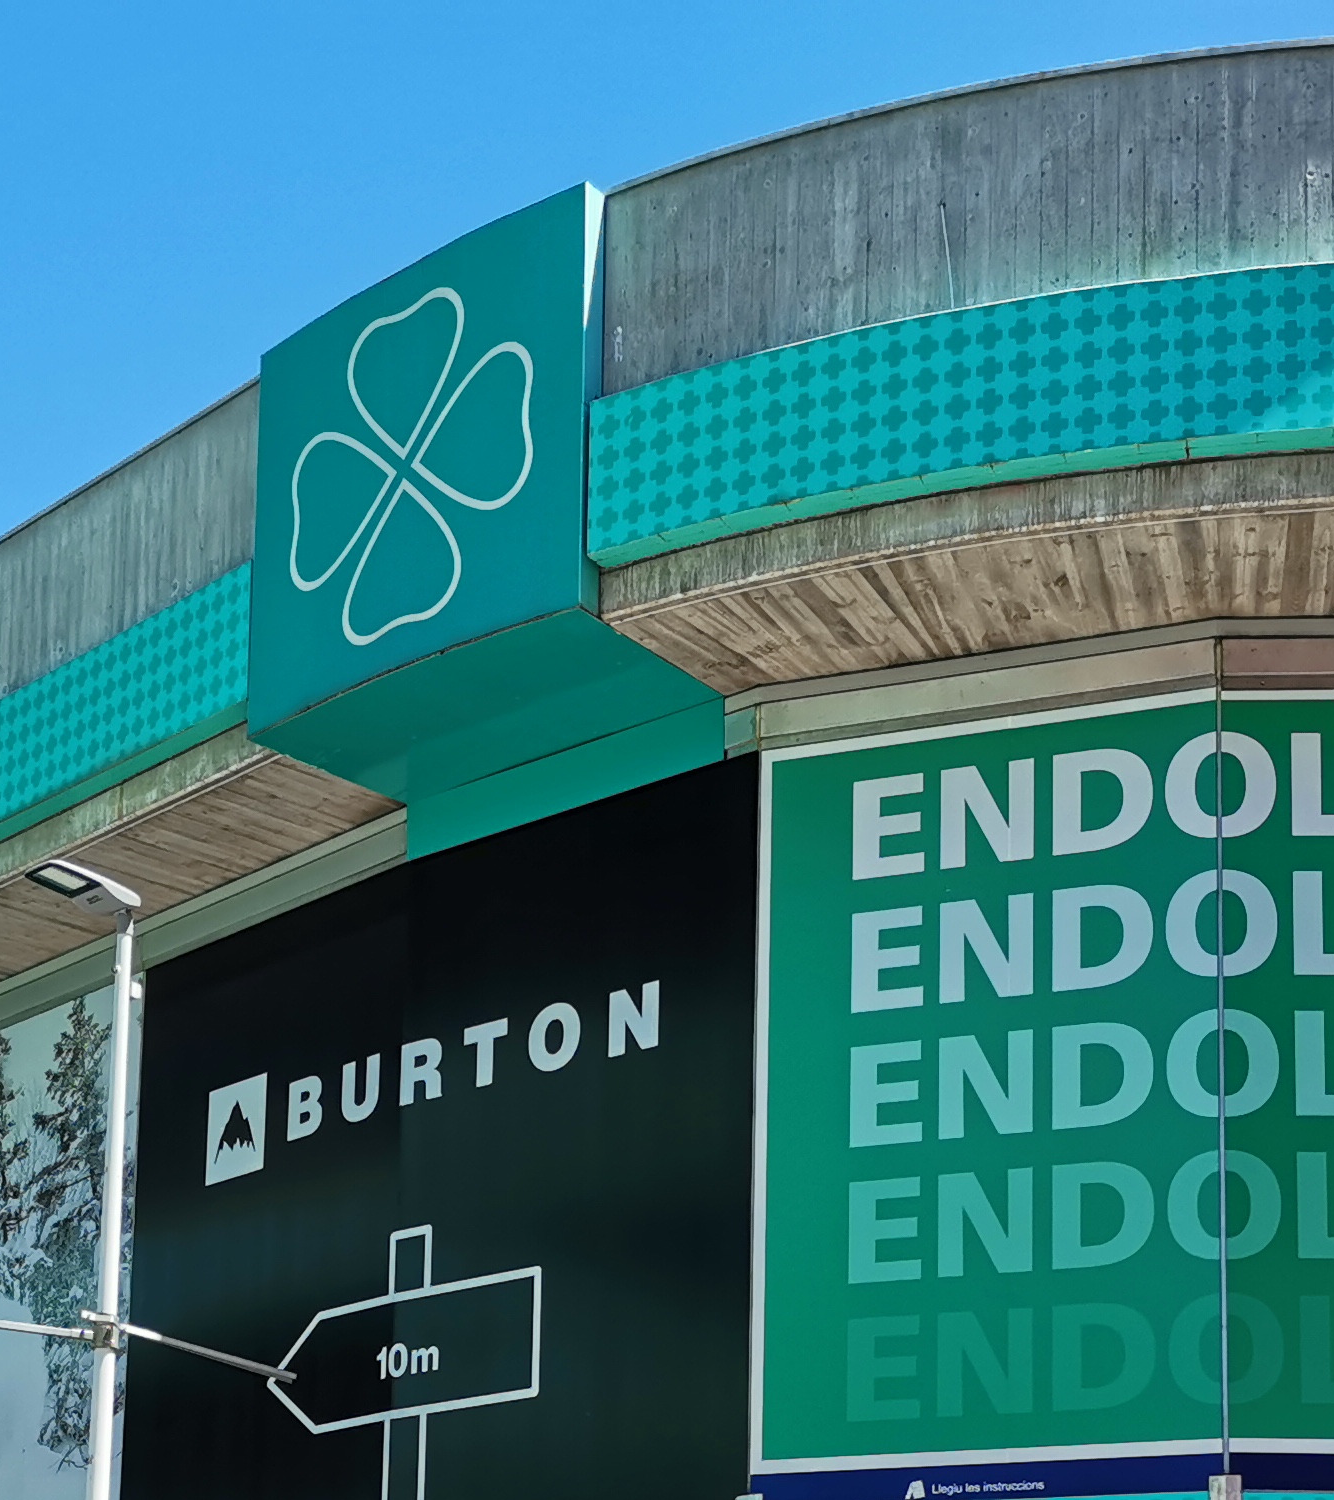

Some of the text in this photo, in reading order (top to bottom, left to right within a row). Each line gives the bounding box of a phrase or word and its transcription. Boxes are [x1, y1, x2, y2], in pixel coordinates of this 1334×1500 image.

[287, 980, 660, 1141] BURTON
[376, 1344, 439, 1380] 10m
[932, 1480, 1045, 1496] Llegiu les instruccions
